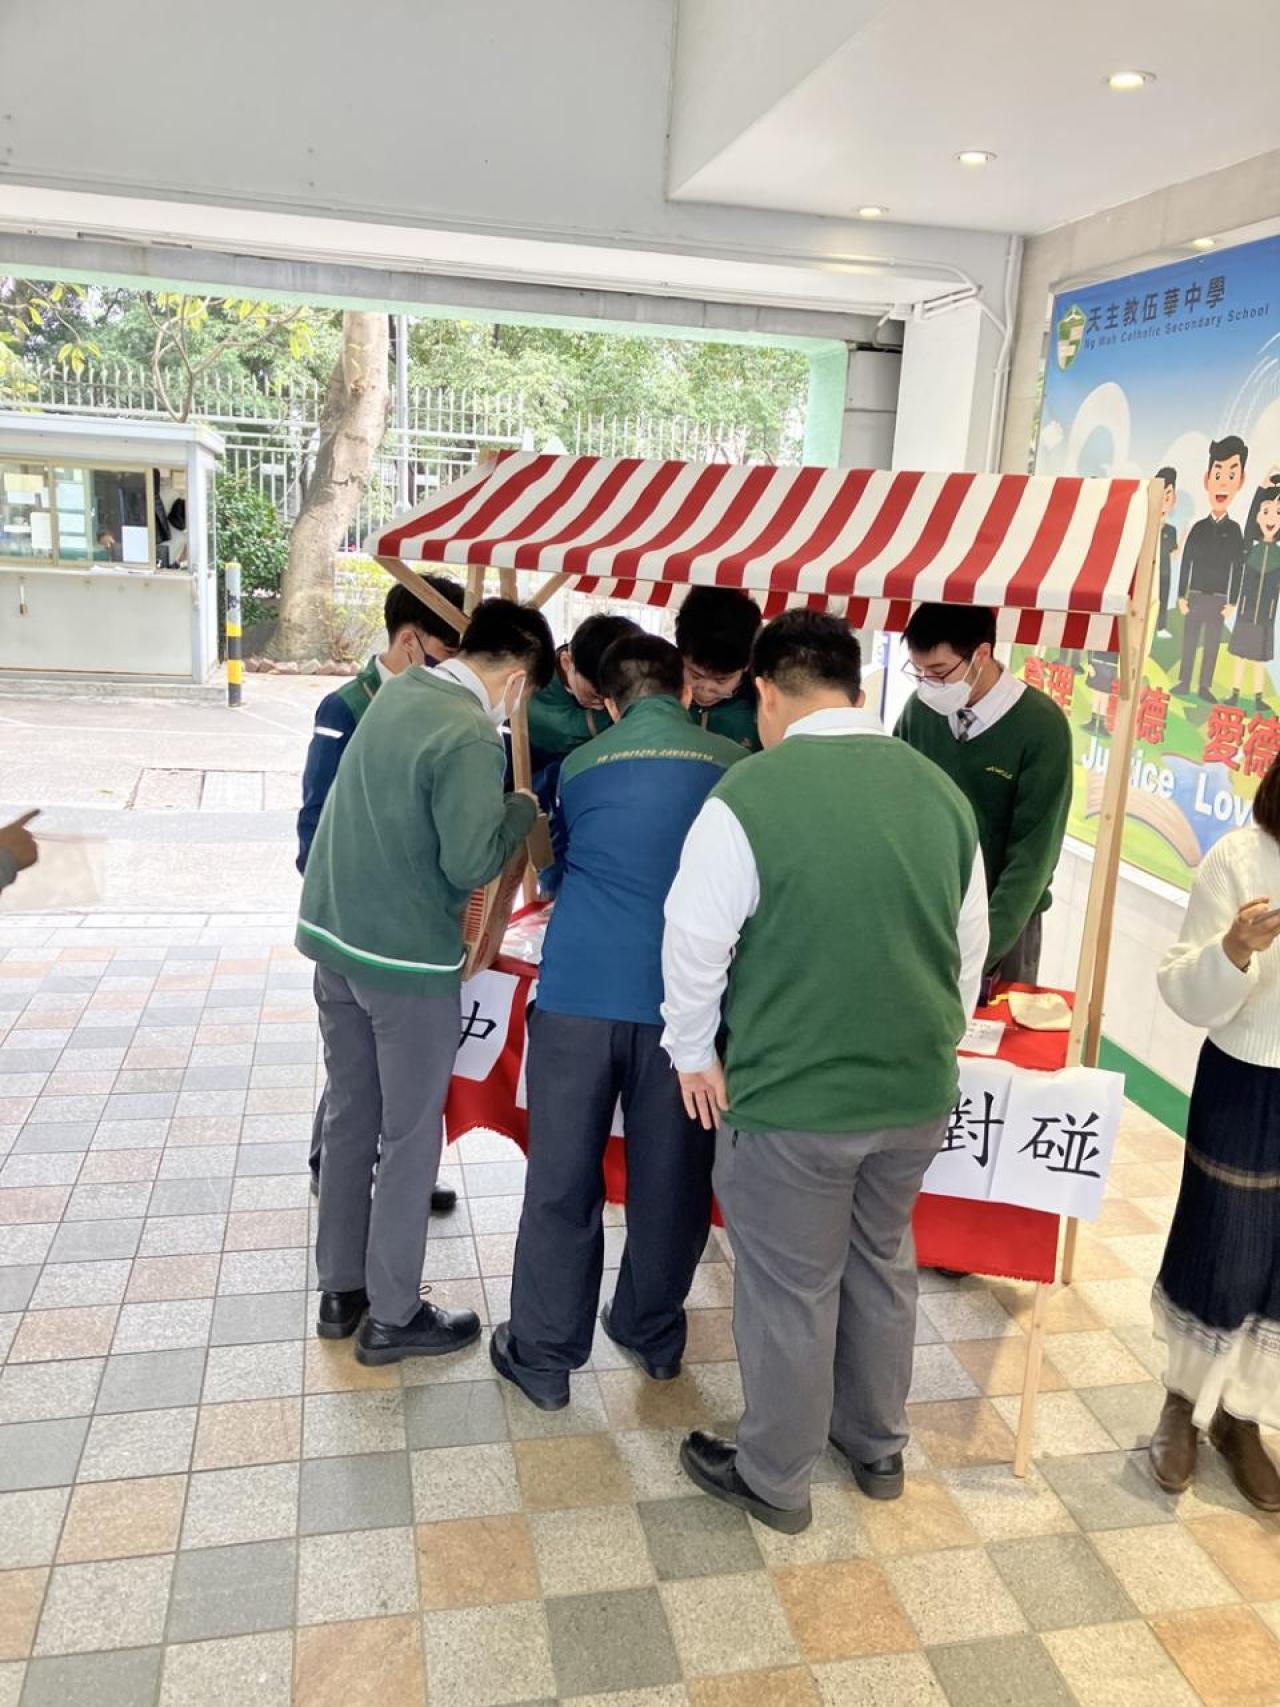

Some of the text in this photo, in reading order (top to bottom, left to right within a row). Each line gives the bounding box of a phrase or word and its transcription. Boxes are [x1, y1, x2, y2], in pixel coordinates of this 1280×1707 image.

[1086, 275, 1225, 333] 天主教伍華中學
[1165, 313, 1222, 335] Secondary
[1227, 303, 1270, 323] School
[1081, 736, 1253, 828] Juice Lov
